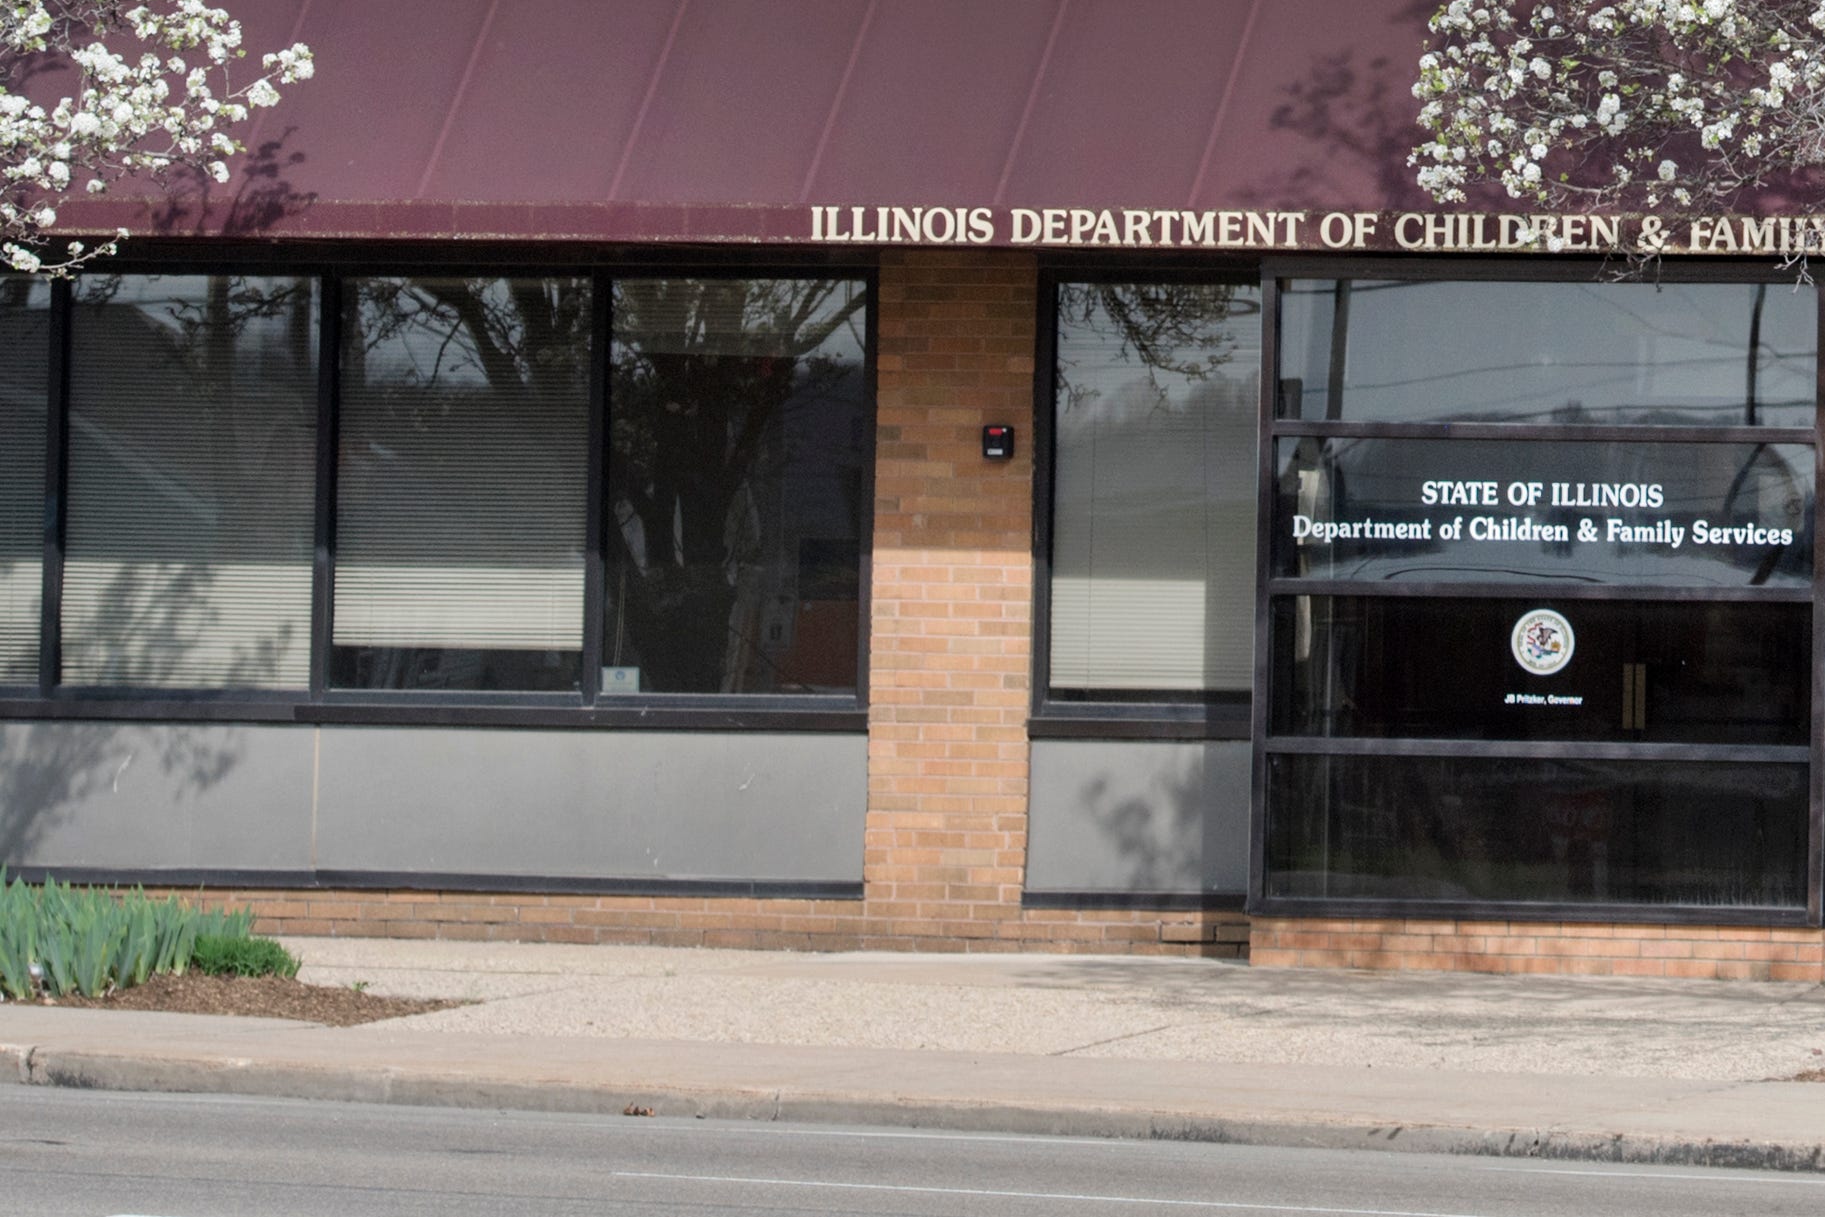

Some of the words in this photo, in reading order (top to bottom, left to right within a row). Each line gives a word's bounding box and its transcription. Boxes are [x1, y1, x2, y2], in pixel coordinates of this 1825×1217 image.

[811, 206, 994, 245] ILLINOIS
[1010, 208, 1305, 248] DEPARTMENT
[1319, 212, 1377, 248] OF
[1394, 213, 1622, 250] CHILDREN
[1637, 214, 1671, 251] &
[1421, 480, 1499, 506] STATE
[1507, 481, 1544, 507] OF
[1551, 482, 1664, 509] ILLINOIS
[1292, 515, 1431, 544] Department
[1439, 516, 1462, 540] of
[1468, 516, 1569, 542] Children
[1576, 518, 1599, 543] &
[1606, 518, 1685, 549] Family
[1692, 519, 1793, 546] Services
